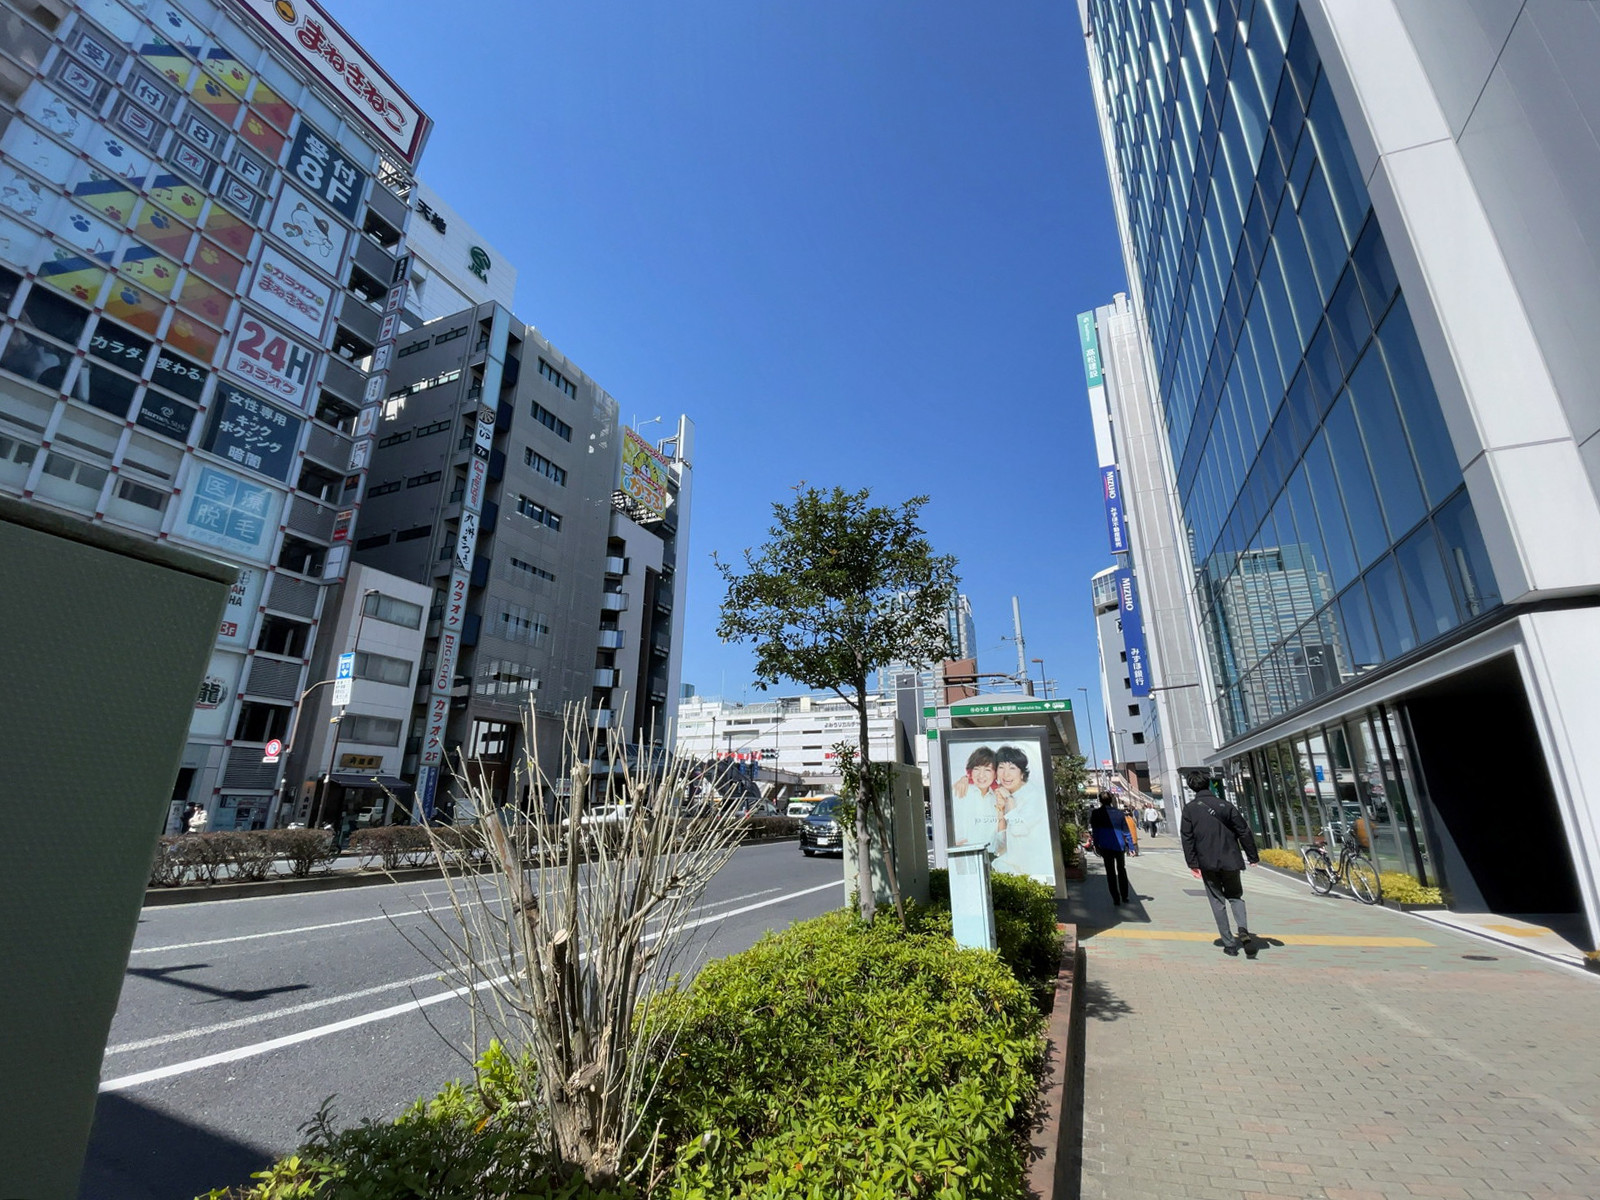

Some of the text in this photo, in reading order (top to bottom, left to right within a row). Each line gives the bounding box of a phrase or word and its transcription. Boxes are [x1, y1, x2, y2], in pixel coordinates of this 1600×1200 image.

[296, 15, 406, 135] まねきねこ
[304, 133, 356, 187] 受付
[296, 155, 352, 204] 8F
[258, 274, 321, 322] まねきねこ
[271, 266, 317, 300] カラオケ
[237, 321, 311, 386] 24H
[237, 357, 297, 395] カラオケ
[228, 391, 287, 427] 女性専用
[236, 415, 272, 436] キック
[219, 421, 282, 453] ボクシング
[228, 445, 262, 469] 暗闇
[205, 475, 265, 511] 医療
[1106, 471, 1116, 499] MIZUHO
[197, 504, 256, 540] 脱毛
[448, 579, 464, 626] カラオケ
[1122, 577, 1134, 611] MIZUHO
[1131, 648, 1144, 686] みずほ銀行
[428, 699, 445, 749] カラオケ
[425, 751, 438, 761] 2F
